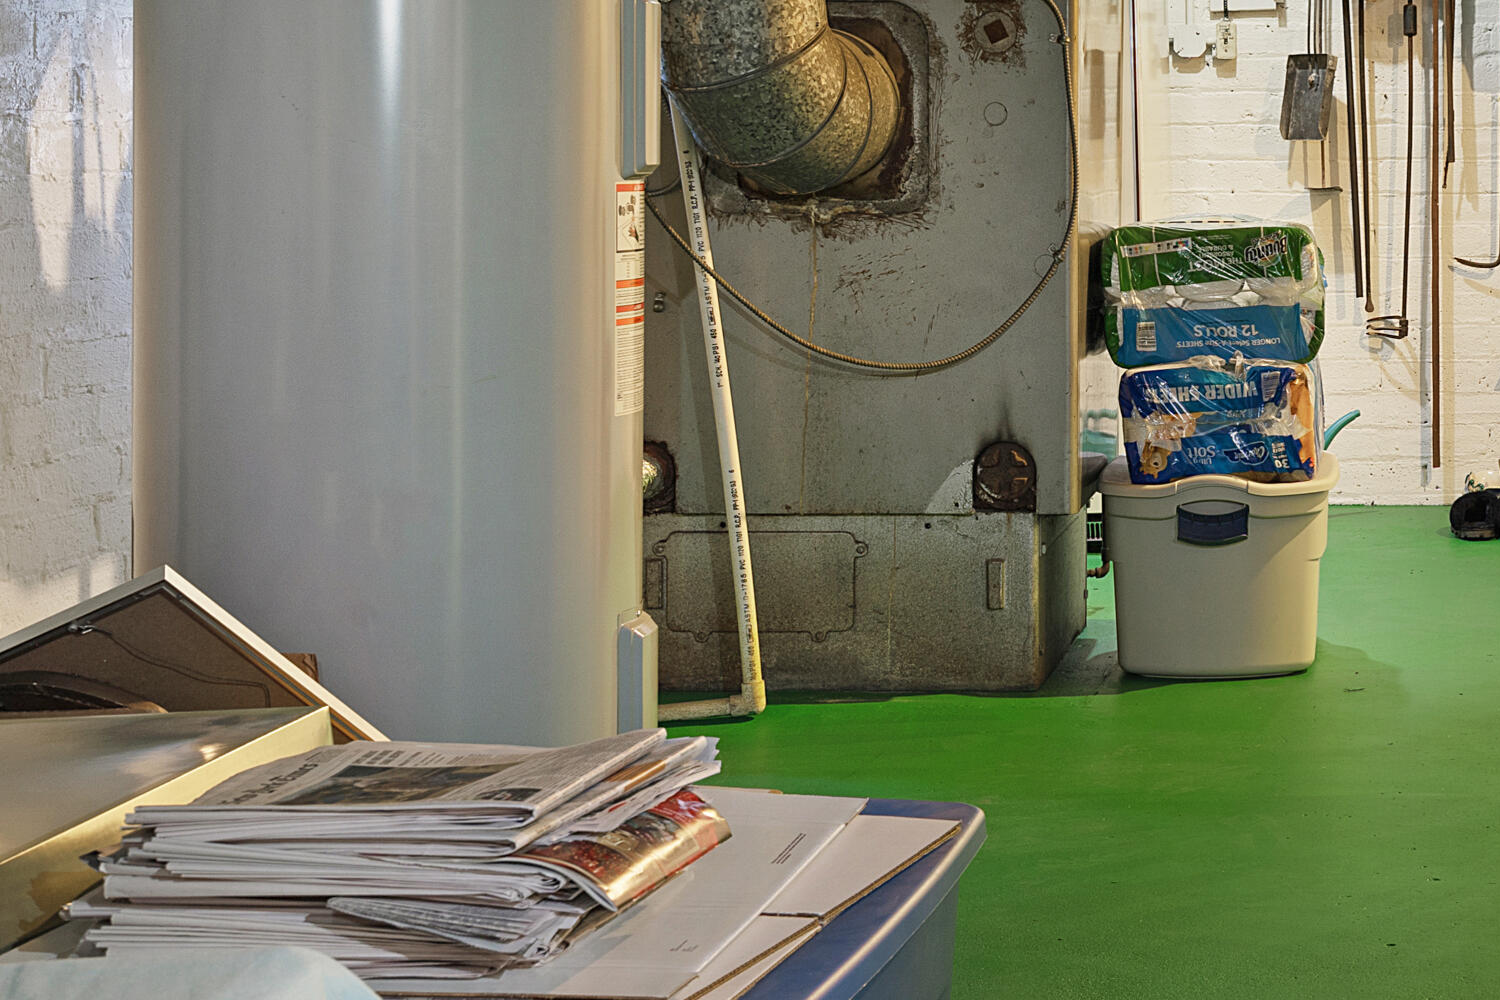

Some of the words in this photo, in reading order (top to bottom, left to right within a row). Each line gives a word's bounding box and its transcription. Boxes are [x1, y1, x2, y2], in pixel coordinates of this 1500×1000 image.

[1244, 236, 1287, 265] Bounty
[1226, 257, 1243, 265] THE
[704, 285, 712, 305] ASTM
[1193, 324, 1237, 338] ROLLS
[1240, 324, 1259, 337] 12
[1176, 340, 1203, 348] SHEETS
[1251, 336, 1281, 346] LONGER
[1204, 381, 1258, 400] WIDER
[1187, 445, 1216, 459] Soft
[1234, 446, 1265, 460] Charin
[1274, 458, 1290, 468] 30
[743, 603, 751, 622] ASTM
